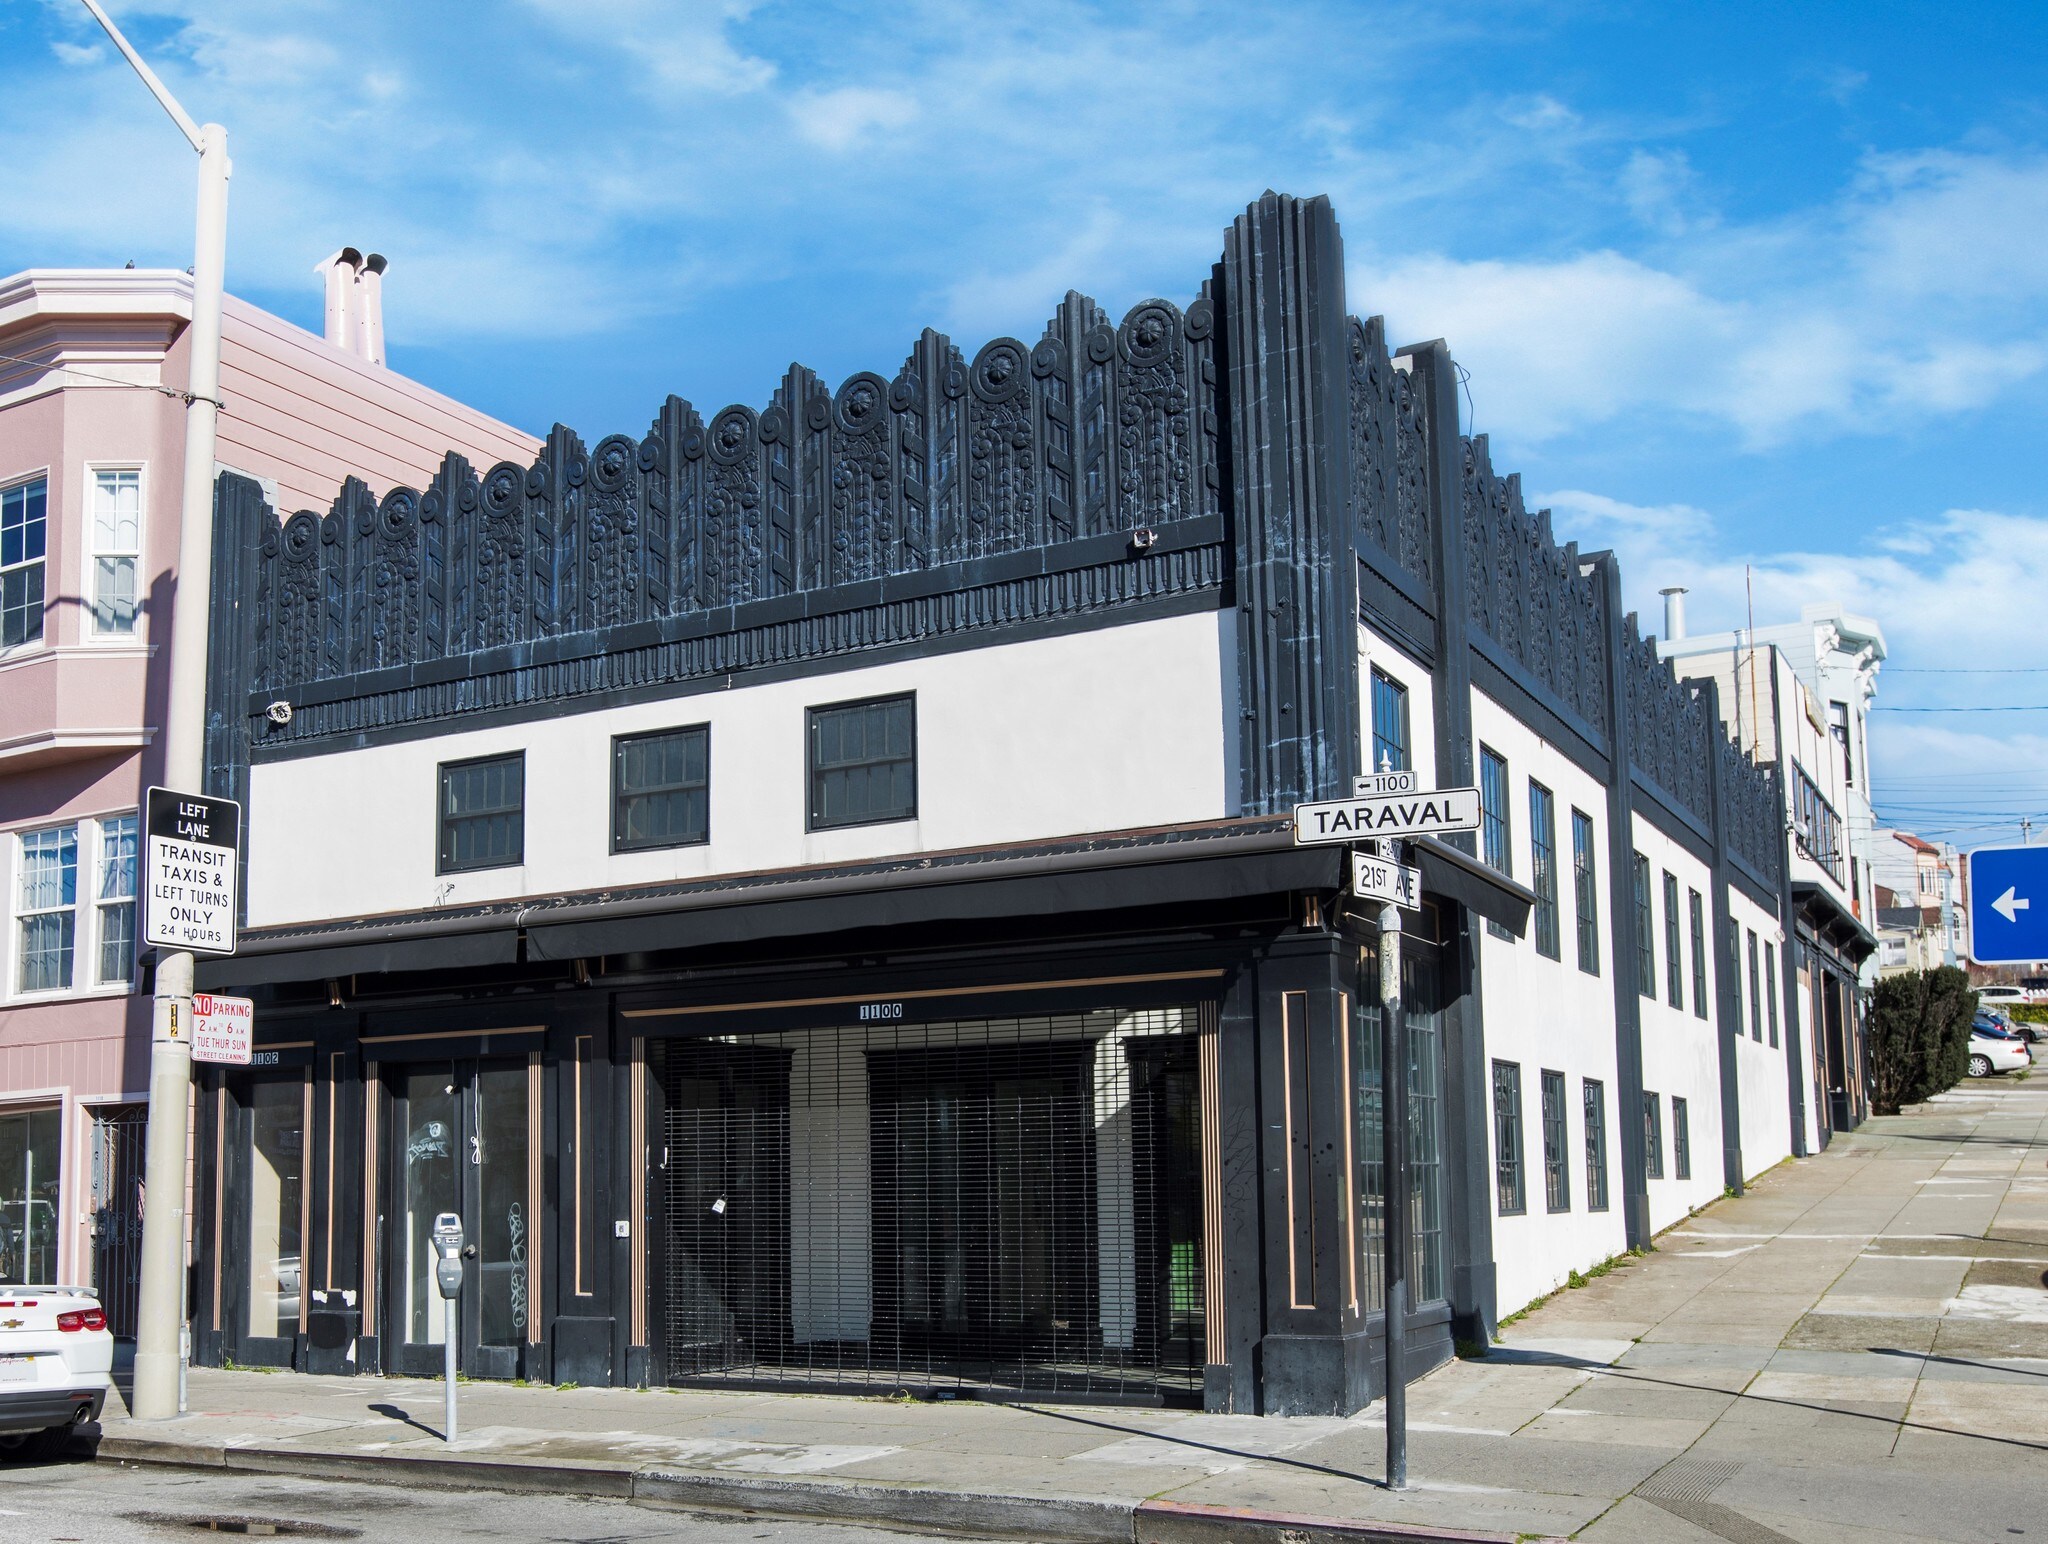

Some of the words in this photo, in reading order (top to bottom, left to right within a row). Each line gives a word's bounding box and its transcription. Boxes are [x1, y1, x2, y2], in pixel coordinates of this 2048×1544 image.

[1376, 775, 1409, 791] 1100
[180, 802, 208, 819] LEFT
[1314, 800, 1463, 834] TARAVAL
[178, 820, 209, 838] LANE
[160, 844, 226, 867] TRANSIT
[162, 864, 208, 884] TAXIS
[213, 873, 223, 887] &
[1361, 865, 1387, 889] 21ST
[1396, 874, 1415, 900] AVE
[155, 884, 183, 901] LEFT
[190, 889, 228, 908] TURNS
[170, 906, 213, 925] ONLY
[161, 924, 175, 936] 24
[183, 927, 221, 942] HOURS
[194, 996, 211, 1015] NO
[213, 1003, 250, 1018] PARKING
[860, 1003, 902, 1019] 1100
[199, 1019, 206, 1032] 2
[227, 1022, 233, 1034] 6
[197, 1036, 210, 1048] TUE
[212, 1037, 230, 1049] THUR
[231, 1039, 247, 1051] SUN
[196, 1050, 217, 1059] STREET
[219, 1052, 246, 1061] CLEANING
